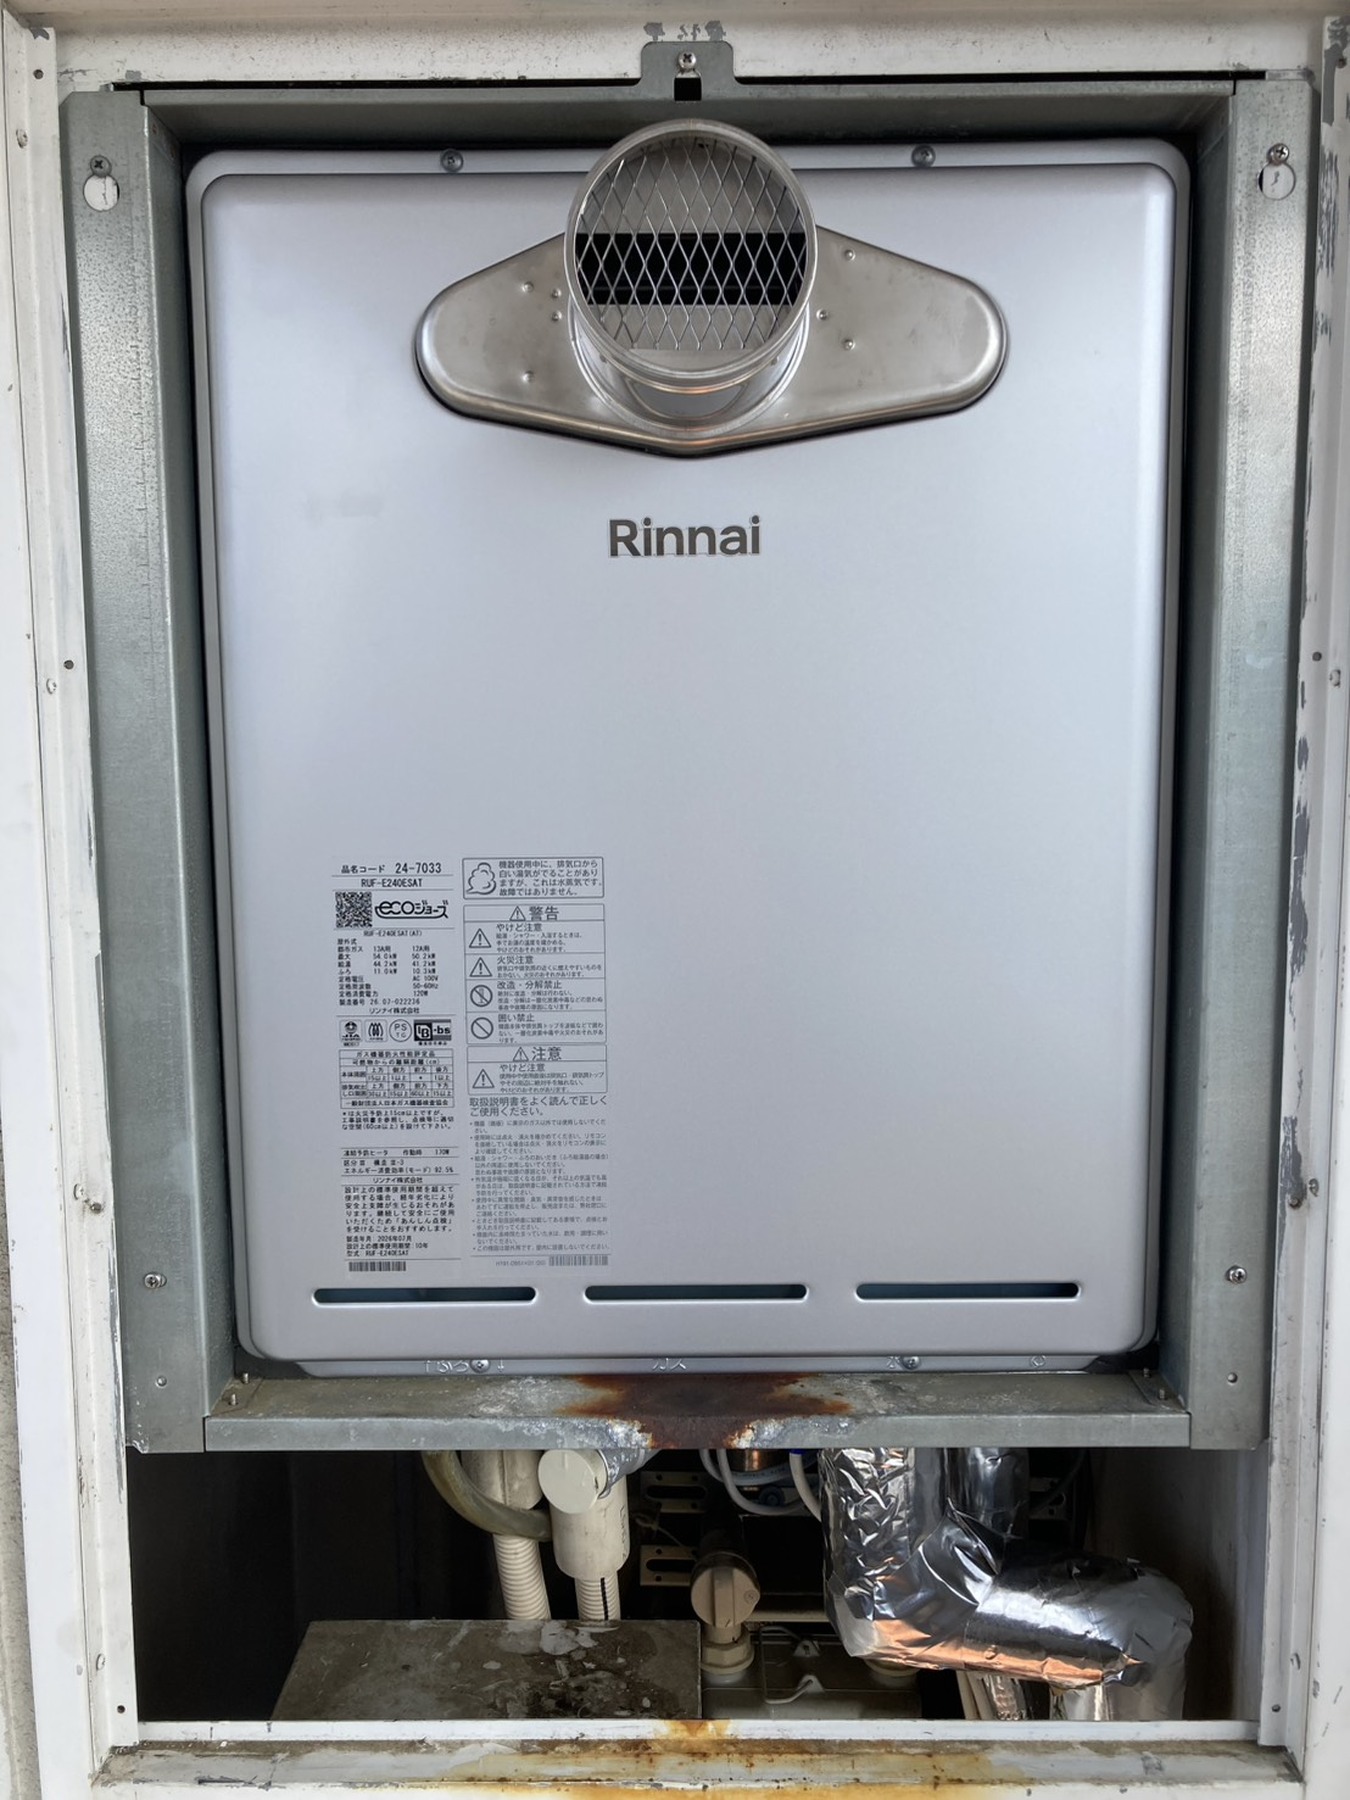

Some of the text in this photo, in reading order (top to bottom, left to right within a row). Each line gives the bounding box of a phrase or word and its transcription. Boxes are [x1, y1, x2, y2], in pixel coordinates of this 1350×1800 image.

[609, 515, 760, 557] Rinnai
[341, 862, 442, 874] 品名コード 24-7033
[361, 878, 423, 888] RUF-E240ESAT
[529, 906, 559, 921] 警告
[496, 923, 542, 932] やけど注意
[497, 956, 534, 965] 火災注意
[497, 981, 563, 990] 改造・分解禁止
[498, 1013, 535, 1023] 囲い禁止
[532, 1047, 562, 1061] 注意
[500, 1064, 545, 1072] やけど注意
[470, 1096, 608, 1107] 取扱説明書をよく読んで正しく
[470, 1107, 544, 1117] ご使用ください。
